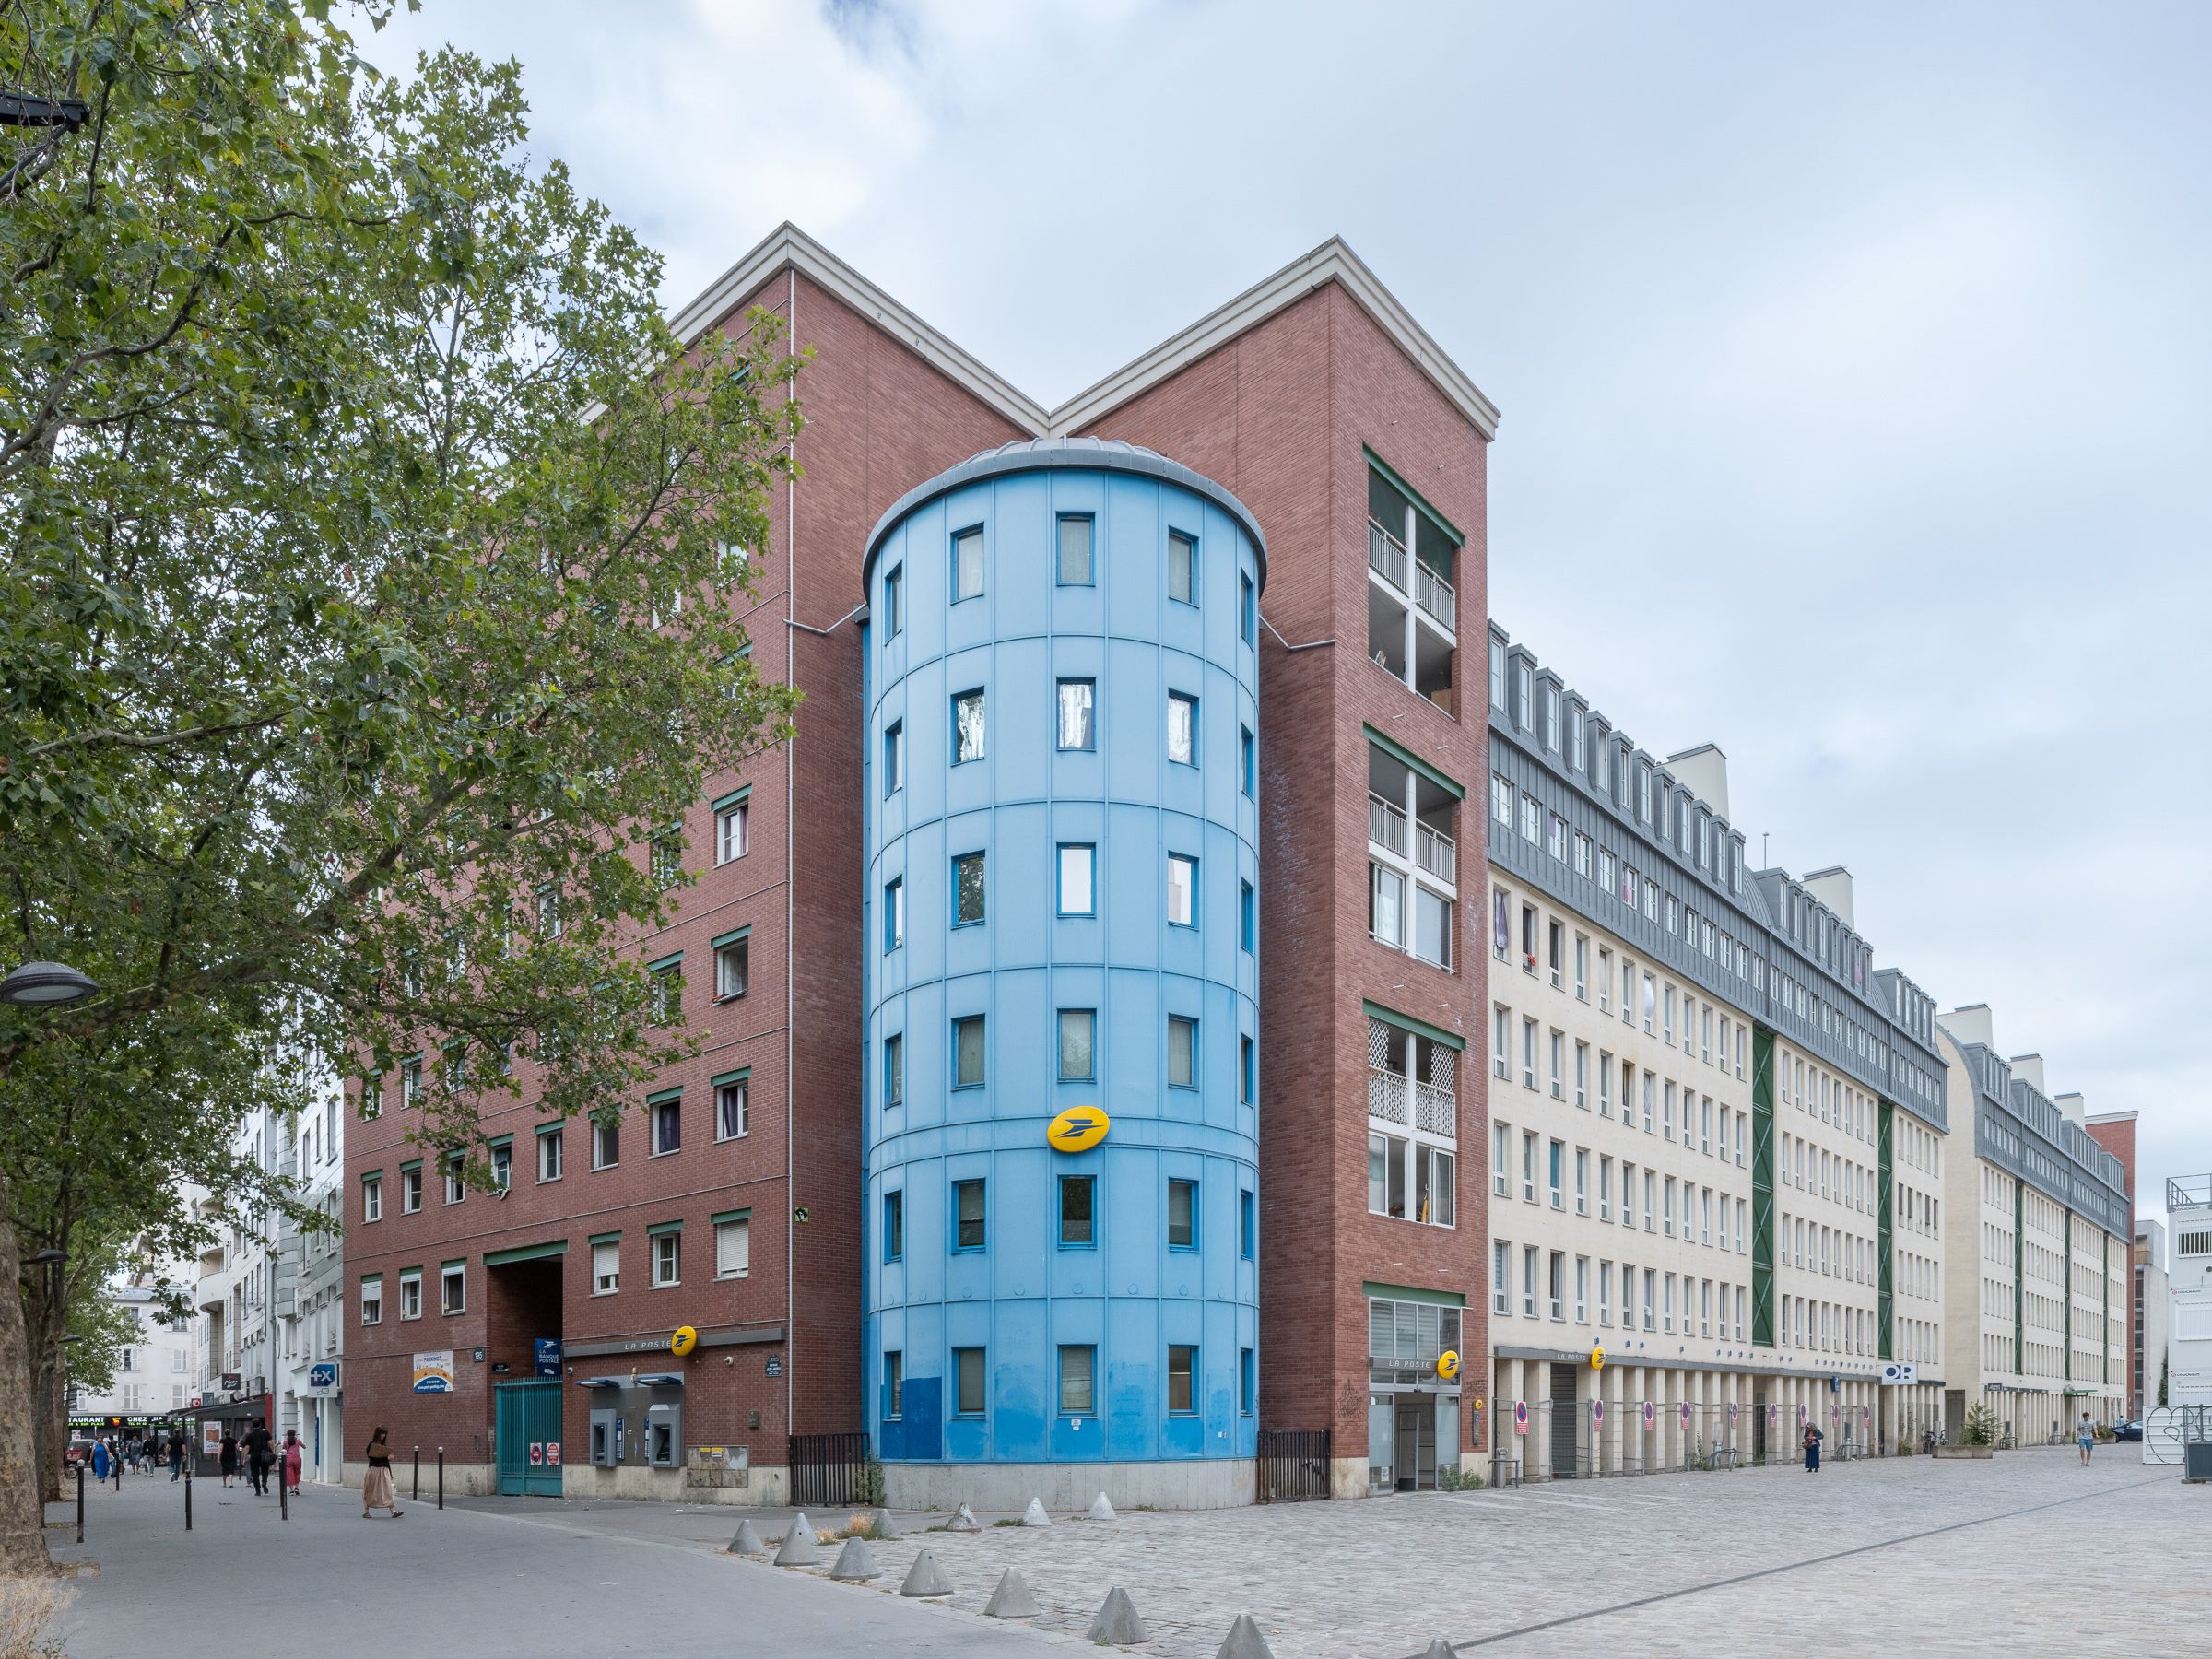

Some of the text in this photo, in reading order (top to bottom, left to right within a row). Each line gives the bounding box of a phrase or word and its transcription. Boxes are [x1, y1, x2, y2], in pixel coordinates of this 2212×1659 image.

[641, 1339, 672, 1349] POSTE
[475, 1351, 483, 1359] 195
[1404, 1360, 1430, 1369] POSTE
